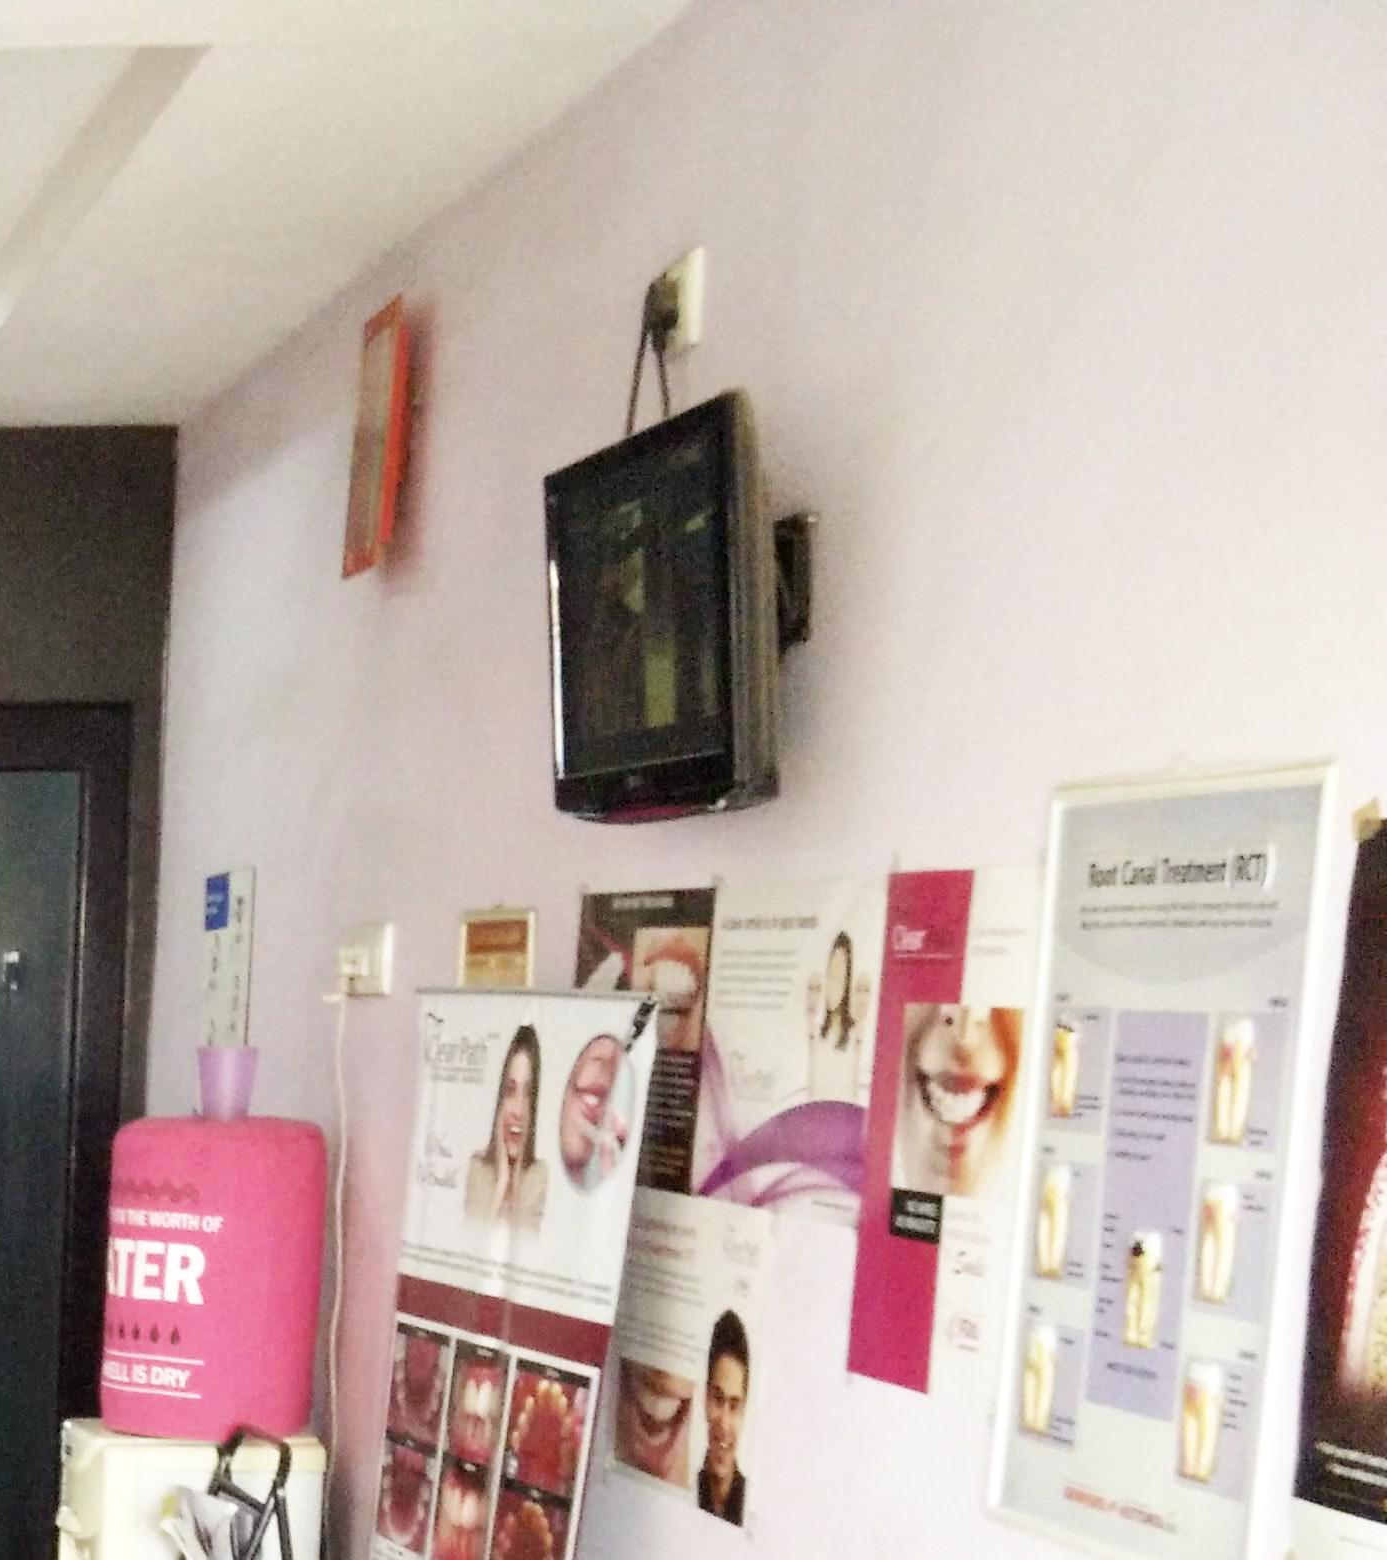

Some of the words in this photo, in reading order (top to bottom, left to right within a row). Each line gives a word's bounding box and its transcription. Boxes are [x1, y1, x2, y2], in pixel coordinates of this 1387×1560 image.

[149, 1210, 200, 1232] WORTH
[202, 1213, 225, 1234] OF
[132, 1363, 148, 1384] IS
[151, 1365, 191, 1389] DRY
